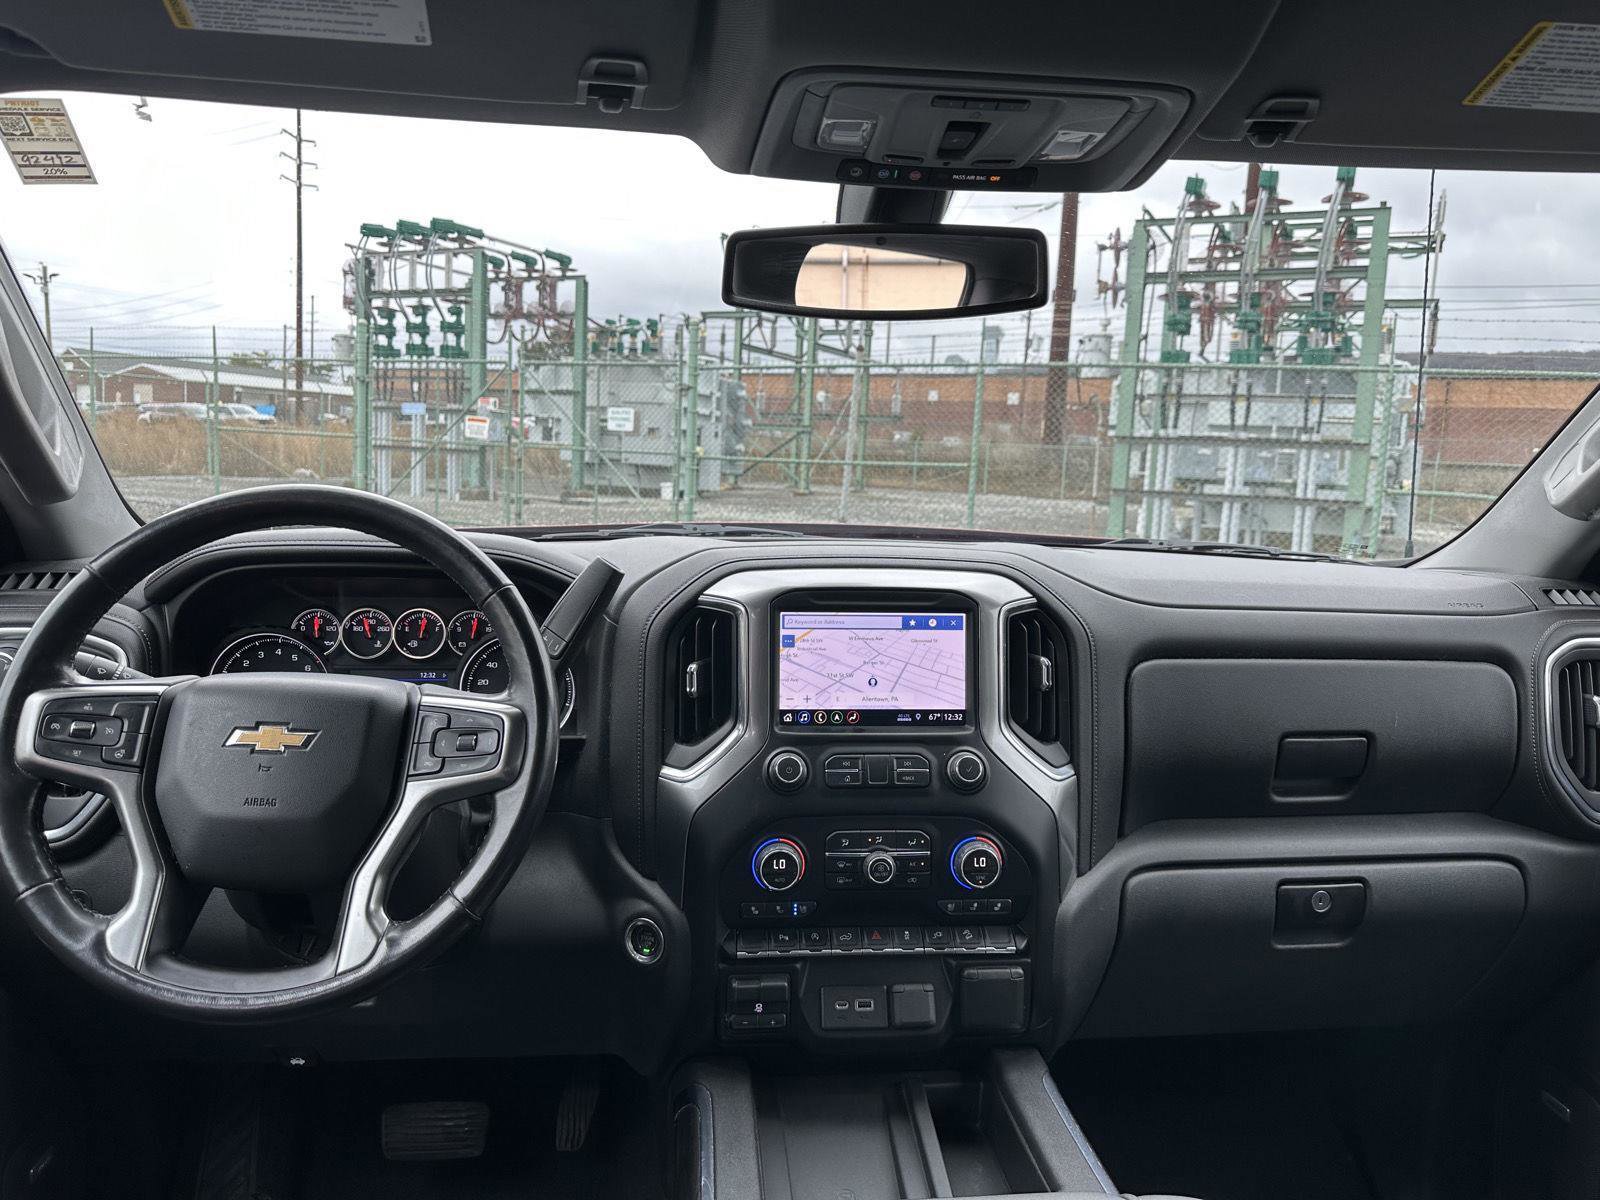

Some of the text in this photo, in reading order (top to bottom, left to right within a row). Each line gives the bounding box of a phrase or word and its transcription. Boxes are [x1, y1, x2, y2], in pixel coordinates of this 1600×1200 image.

[477, 678, 489, 686] 20
[944, 713, 963, 721] 12:32
[243, 797, 277, 807] AIRBAG
[773, 859, 786, 870] LO
[973, 857, 986, 867] LO
